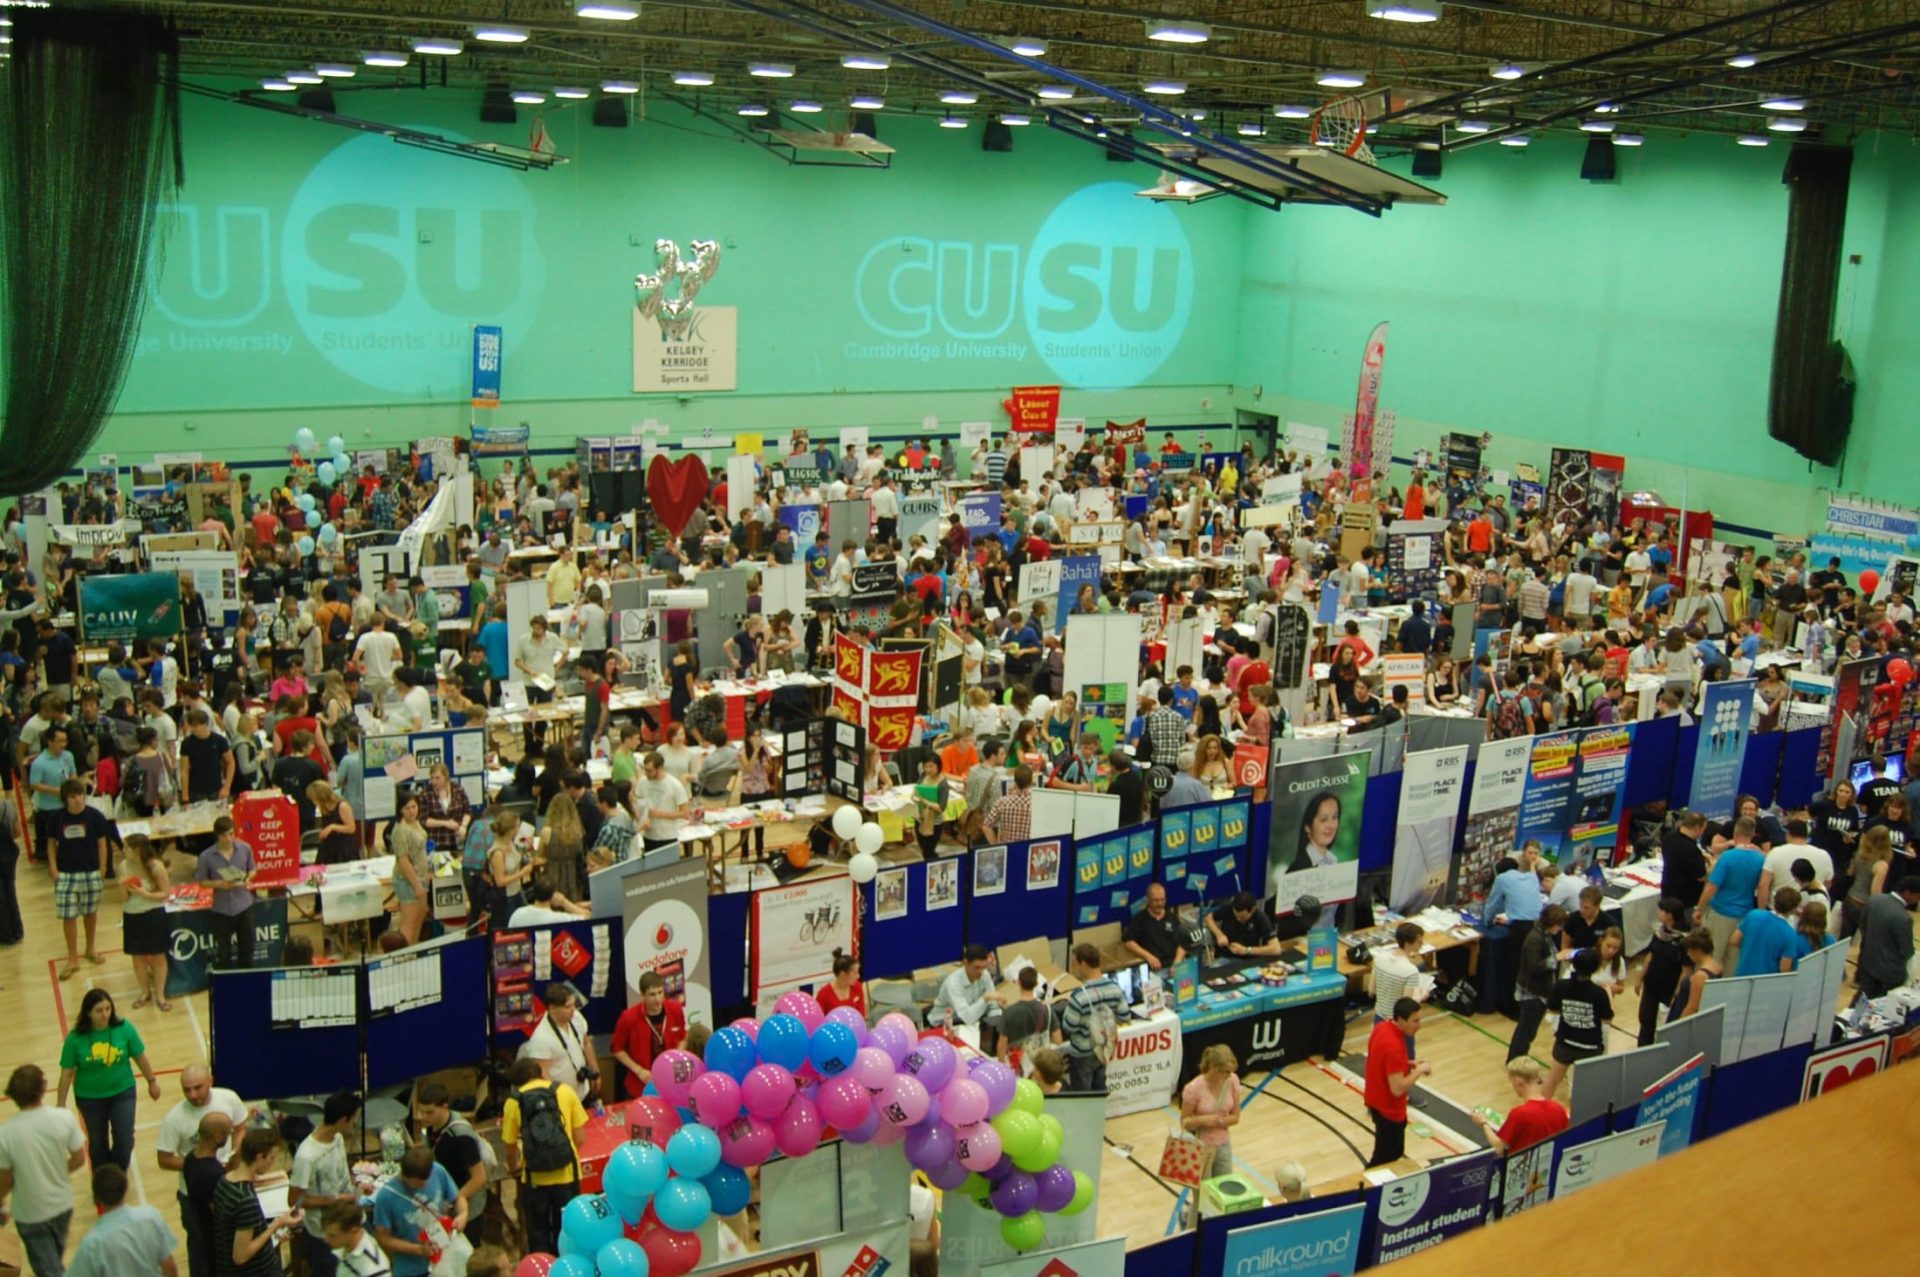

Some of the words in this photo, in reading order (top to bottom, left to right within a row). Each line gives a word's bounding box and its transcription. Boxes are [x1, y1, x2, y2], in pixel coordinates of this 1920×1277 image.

[150, 202, 525, 328] USU
[854, 235, 1182, 340] CUSU
[169, 331, 294, 356] University
[322, 329, 432, 350] Students'
[666, 346, 705, 356] KELSEY
[843, 341, 941, 361] Cambridge
[945, 341, 1027, 361] University
[1044, 342, 1116, 358] Students'
[1119, 343, 1162, 358] Union
[661, 358, 709, 367] KERRIDGE
[661, 374, 690, 384] Sports
[693, 374, 709, 383] Hall
[1019, 398, 1051, 409] Labour
[1828, 507, 1885, 529] CHRISTIAN
[76, 527, 123, 547] improv
[83, 609, 138, 628] CAUV
[416, 754, 441, 767] rag
[1444, 756, 1460, 767] RBS
[1288, 778, 1321, 794] CREDIT
[1321, 774, 1350, 788] SUISSE
[1873, 786, 1900, 797] TEAM
[260, 820, 283, 830] KEEP
[258, 830, 285, 841] CALM
[258, 849, 286, 860] TALK
[256, 860, 283, 871] BOUT
[284, 858, 294, 868] IT
[638, 948, 689, 970] vodafone
[1252, 1017, 1283, 1050] W
[1108, 1028, 1173, 1062] UNDS
[1133, 1063, 1153, 1075] CB2
[1156, 1060, 1171, 1071] 1LA
[1124, 1076, 1150, 1089] 0053
[1381, 1220, 1430, 1247] Instant
[1430, 1203, 1483, 1230] student
[1236, 1228, 1351, 1277] milkround
[1379, 1233, 1444, 1264] insurance
